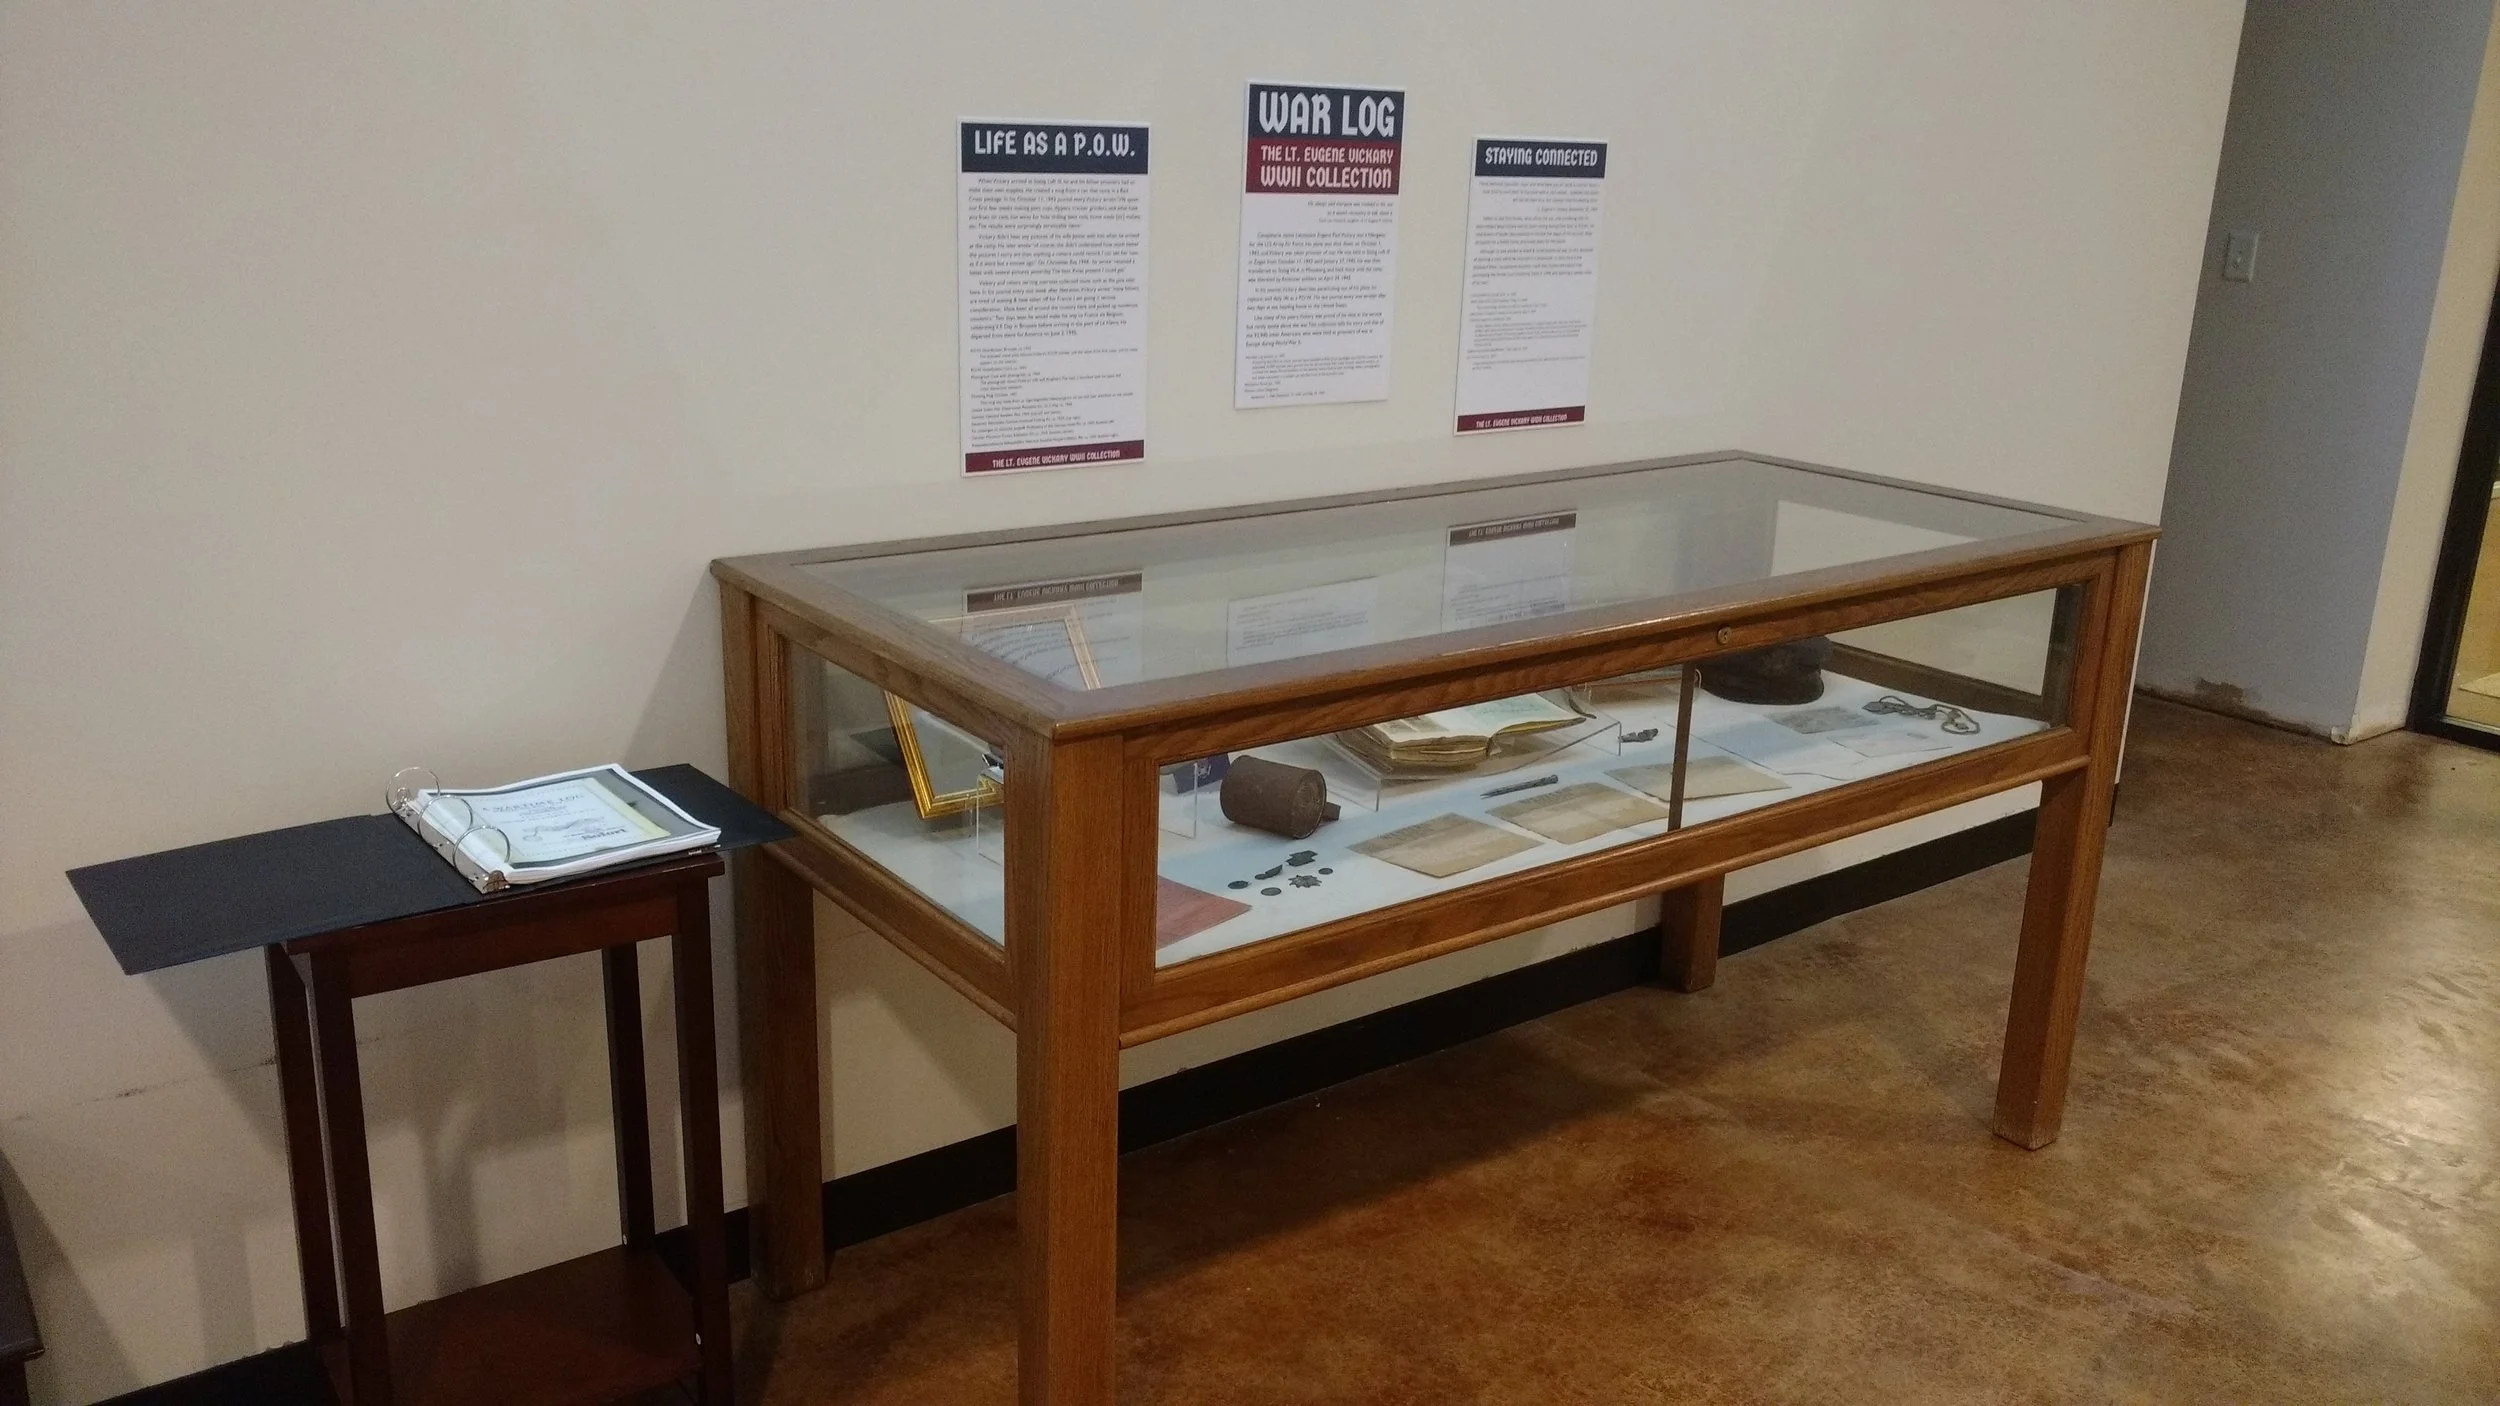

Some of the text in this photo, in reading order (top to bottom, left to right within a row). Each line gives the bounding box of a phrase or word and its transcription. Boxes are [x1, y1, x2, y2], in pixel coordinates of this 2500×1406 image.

[1260, 91, 1395, 138] WAR LOG
[974, 130, 1135, 157] LIFE AS A P.O.W.
[1261, 145, 1394, 164] THE LT. EUGENE VICKARY
[1485, 146, 1598, 167] STAYING CONNECTED
[1260, 166, 1392, 188] WWII COLLECTION
[992, 459, 1004, 468] THE
[1016, 457, 1040, 467] EUGENE
[1042, 454, 1068, 464] VICKARY
[1070, 453, 1086, 462] WWII
[1087, 450, 1120, 460] COLLECTION
